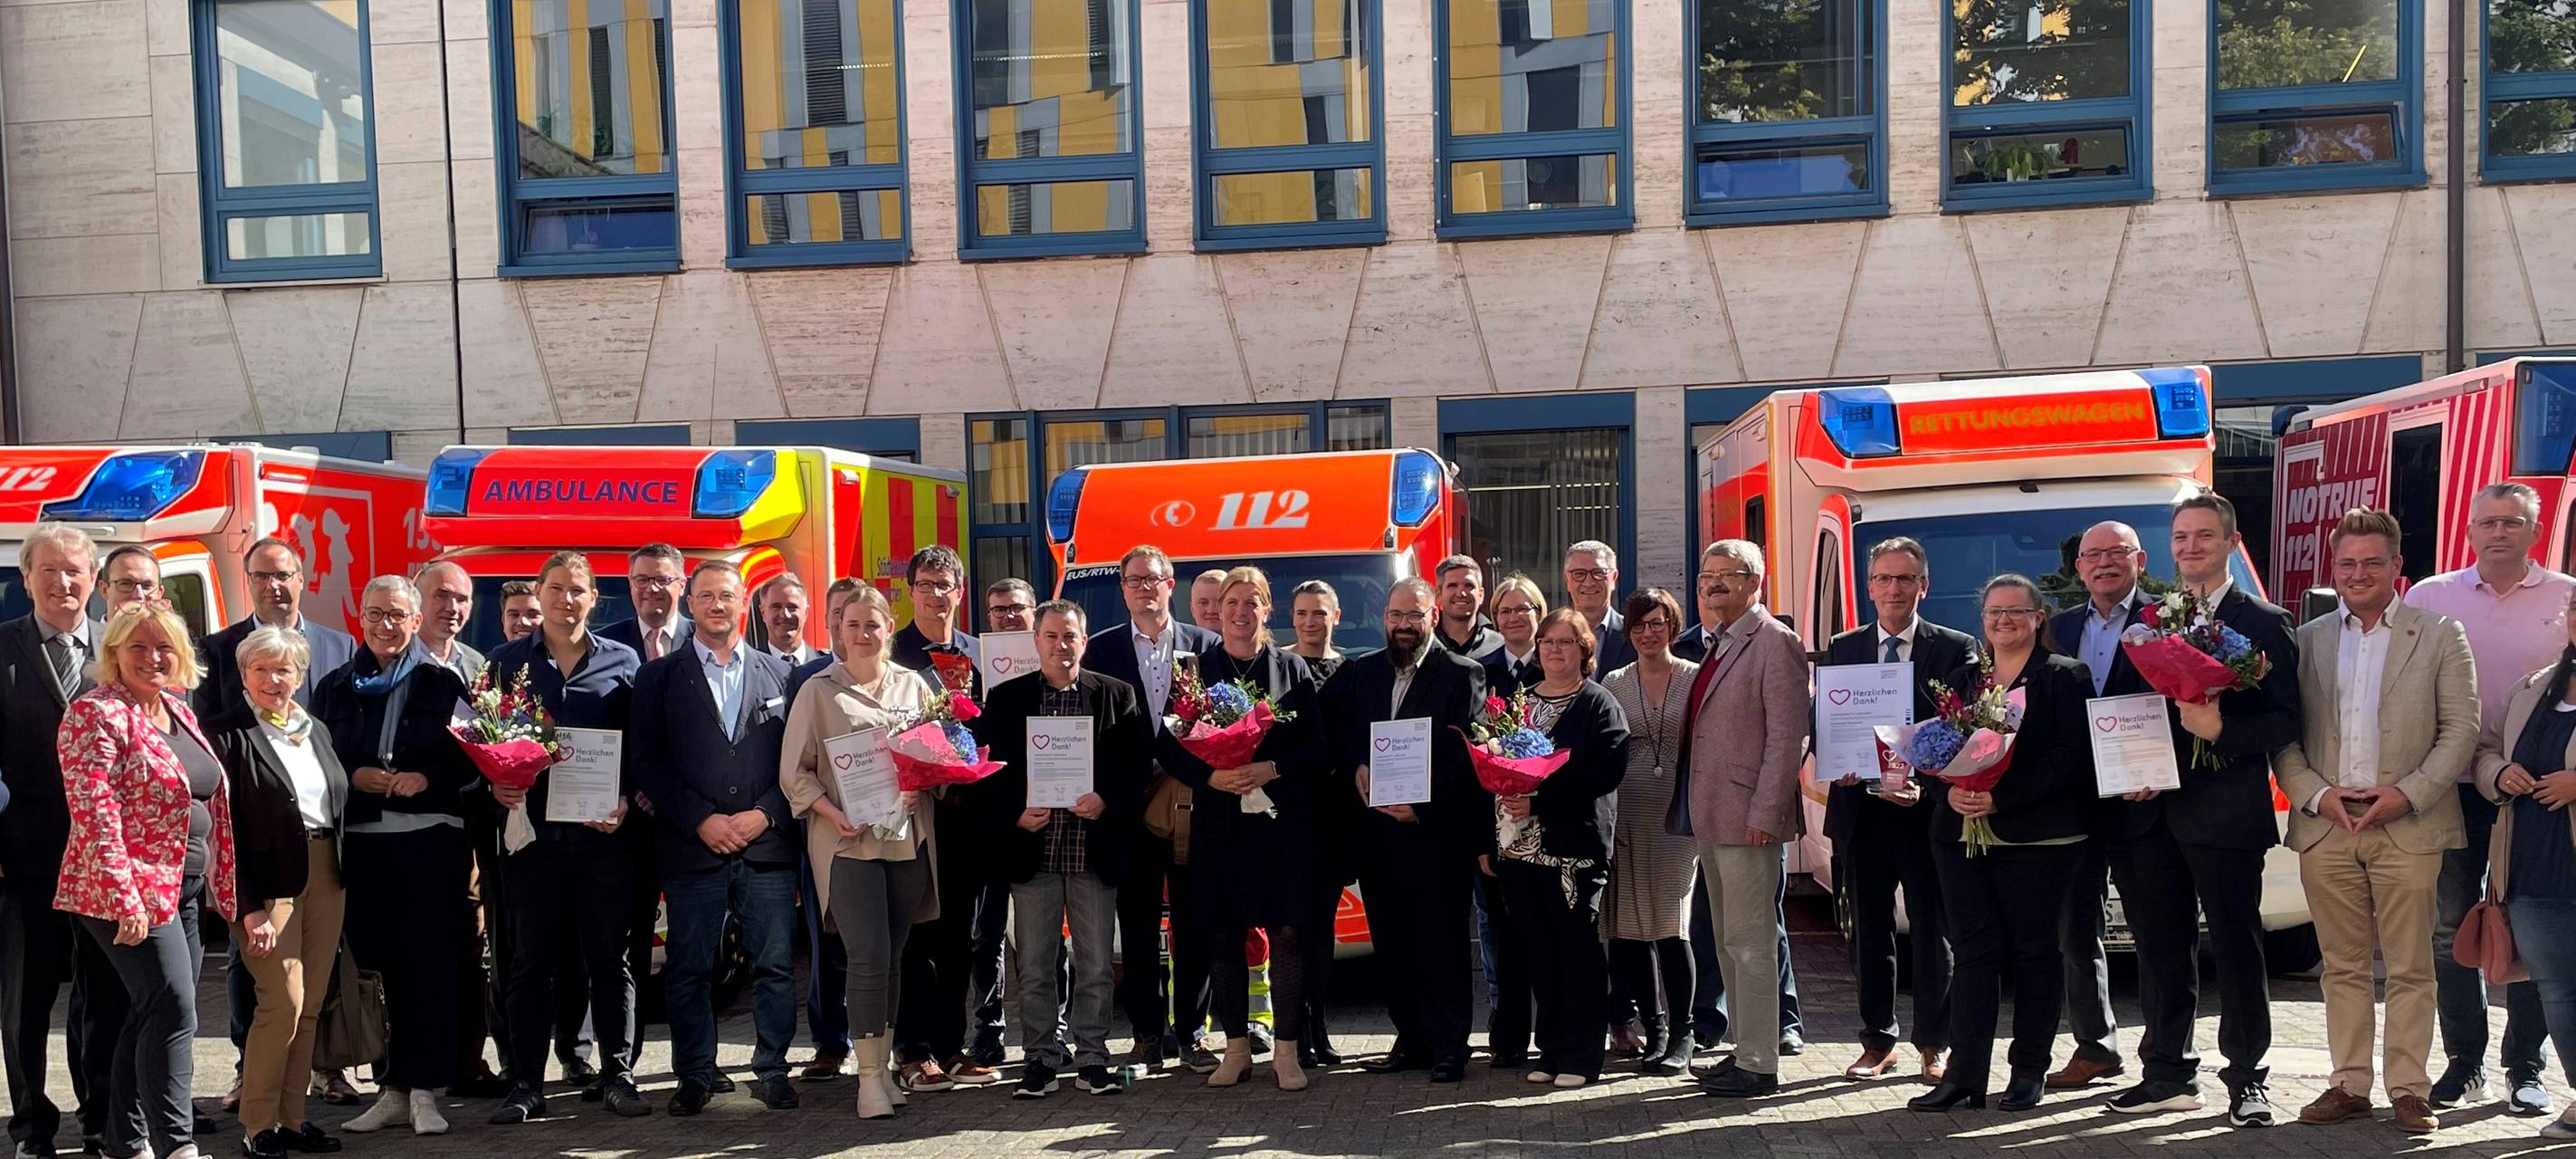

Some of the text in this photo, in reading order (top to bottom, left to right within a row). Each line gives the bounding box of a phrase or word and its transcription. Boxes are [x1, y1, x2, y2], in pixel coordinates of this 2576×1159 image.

[1910, 403, 2144, 435] RETTUNGSWAGEN
[483, 480, 678, 503] AMBULANCE
[1207, 490, 1310, 531] 112
[2285, 533, 2315, 571] 112
[1014, 657, 1040, 666] Herzlic
[1853, 689, 1898, 697] Herzlichen
[2119, 714, 2161, 723] Herzlichen
[2120, 723, 2143, 731] Dank!
[576, 747, 614, 757] Herzlichen
